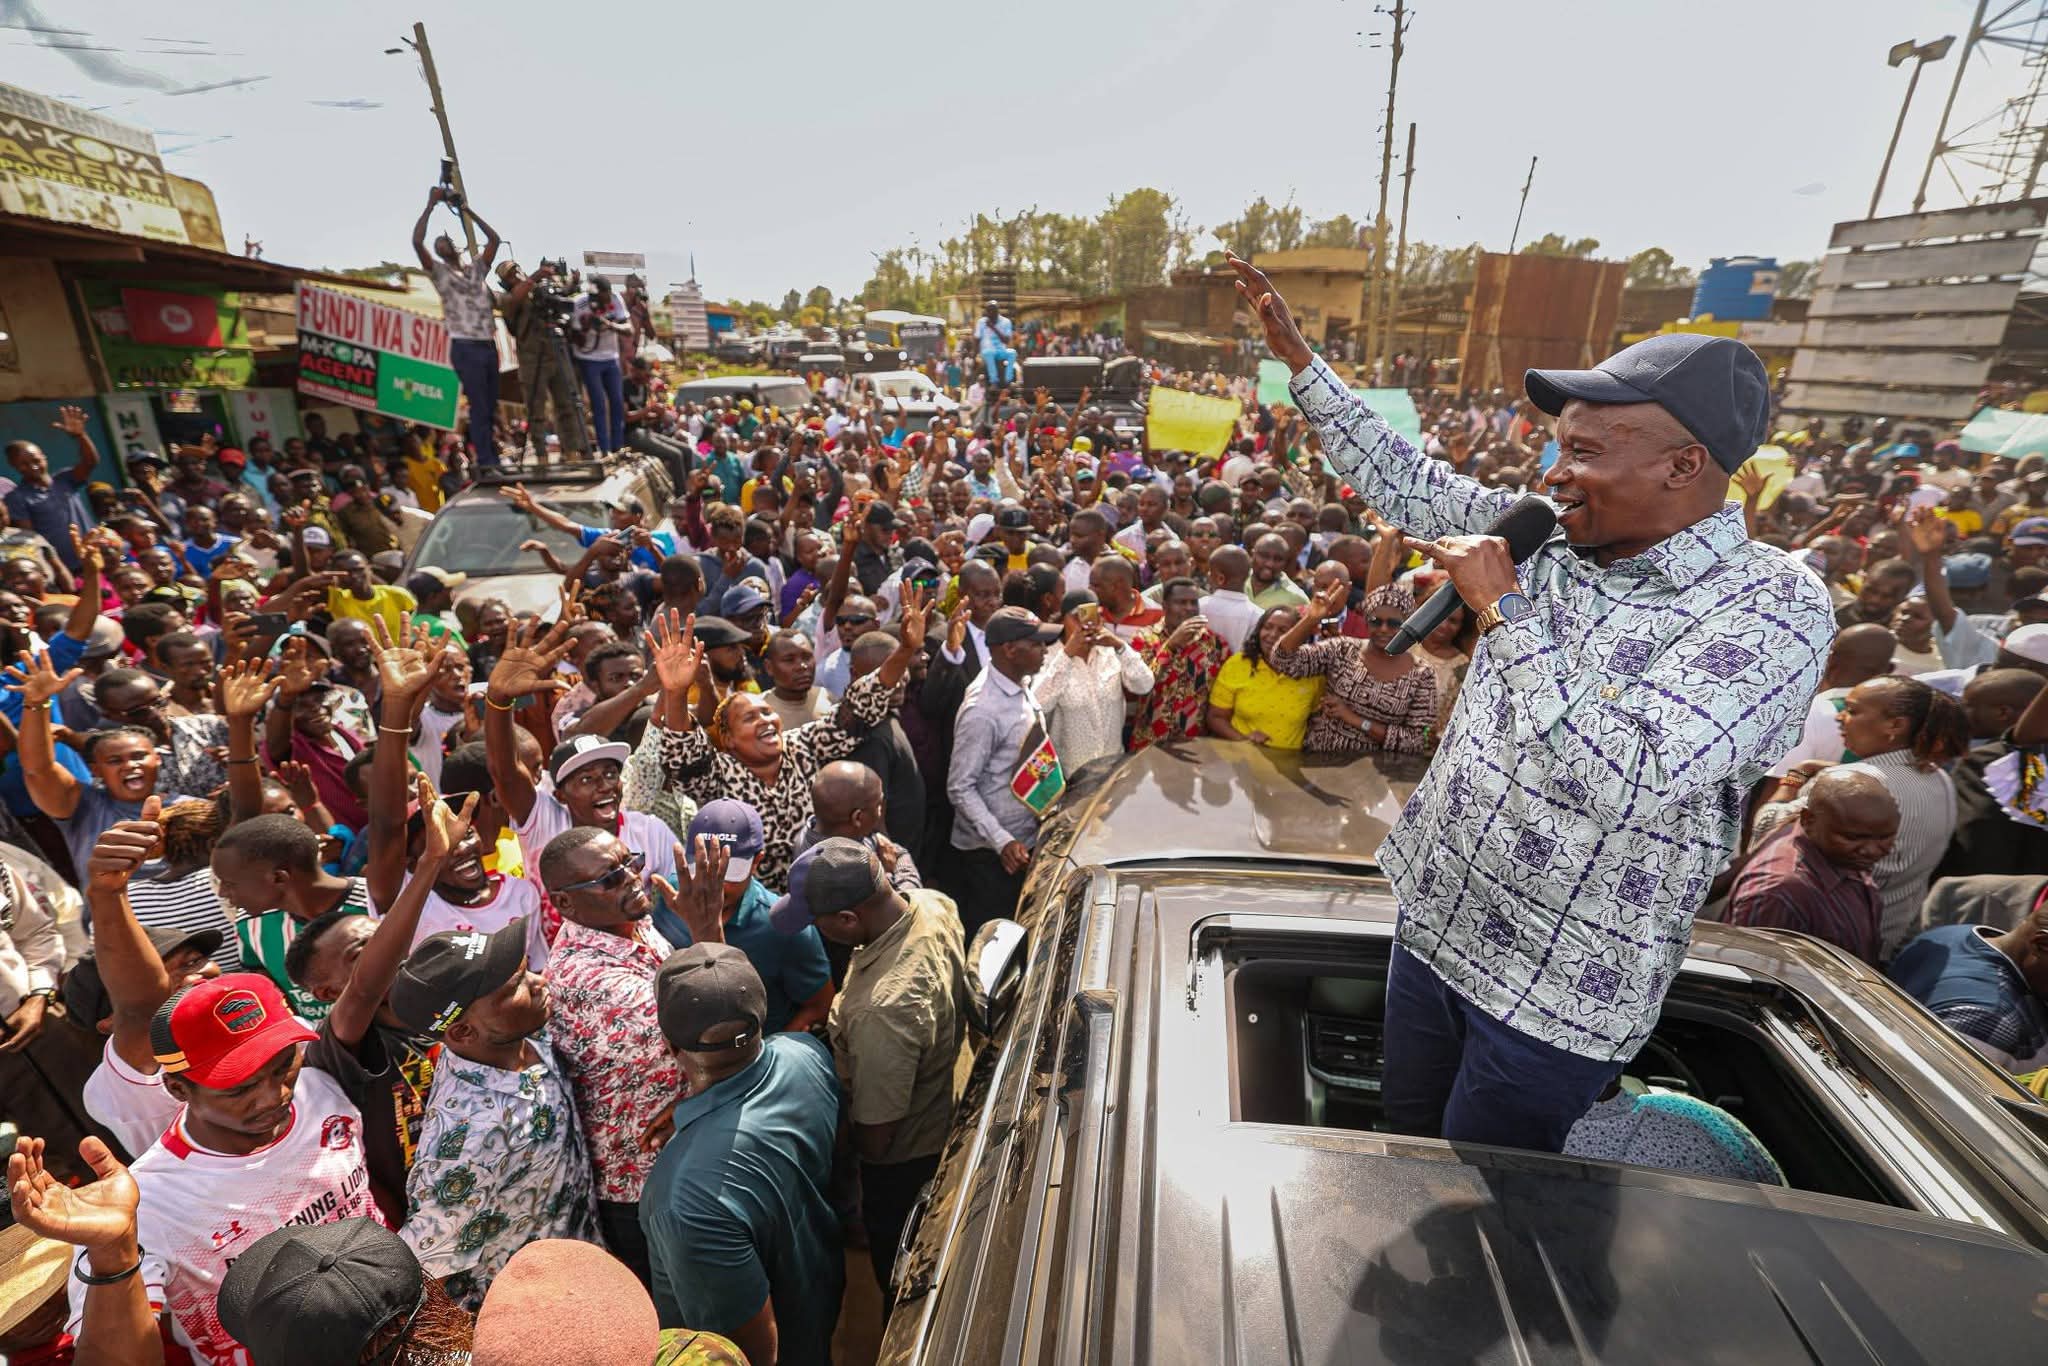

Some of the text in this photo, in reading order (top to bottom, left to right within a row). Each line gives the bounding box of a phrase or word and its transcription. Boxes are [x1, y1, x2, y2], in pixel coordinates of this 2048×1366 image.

[0, 119, 161, 177] M-KOPA
[0, 137, 164, 193] AGENT
[89, 181, 119, 195] TO
[301, 287, 364, 343] FUNDI
[372, 306, 403, 353] WA
[301, 353, 375, 387] AGENT
[698, 832, 738, 842] RIGLE
